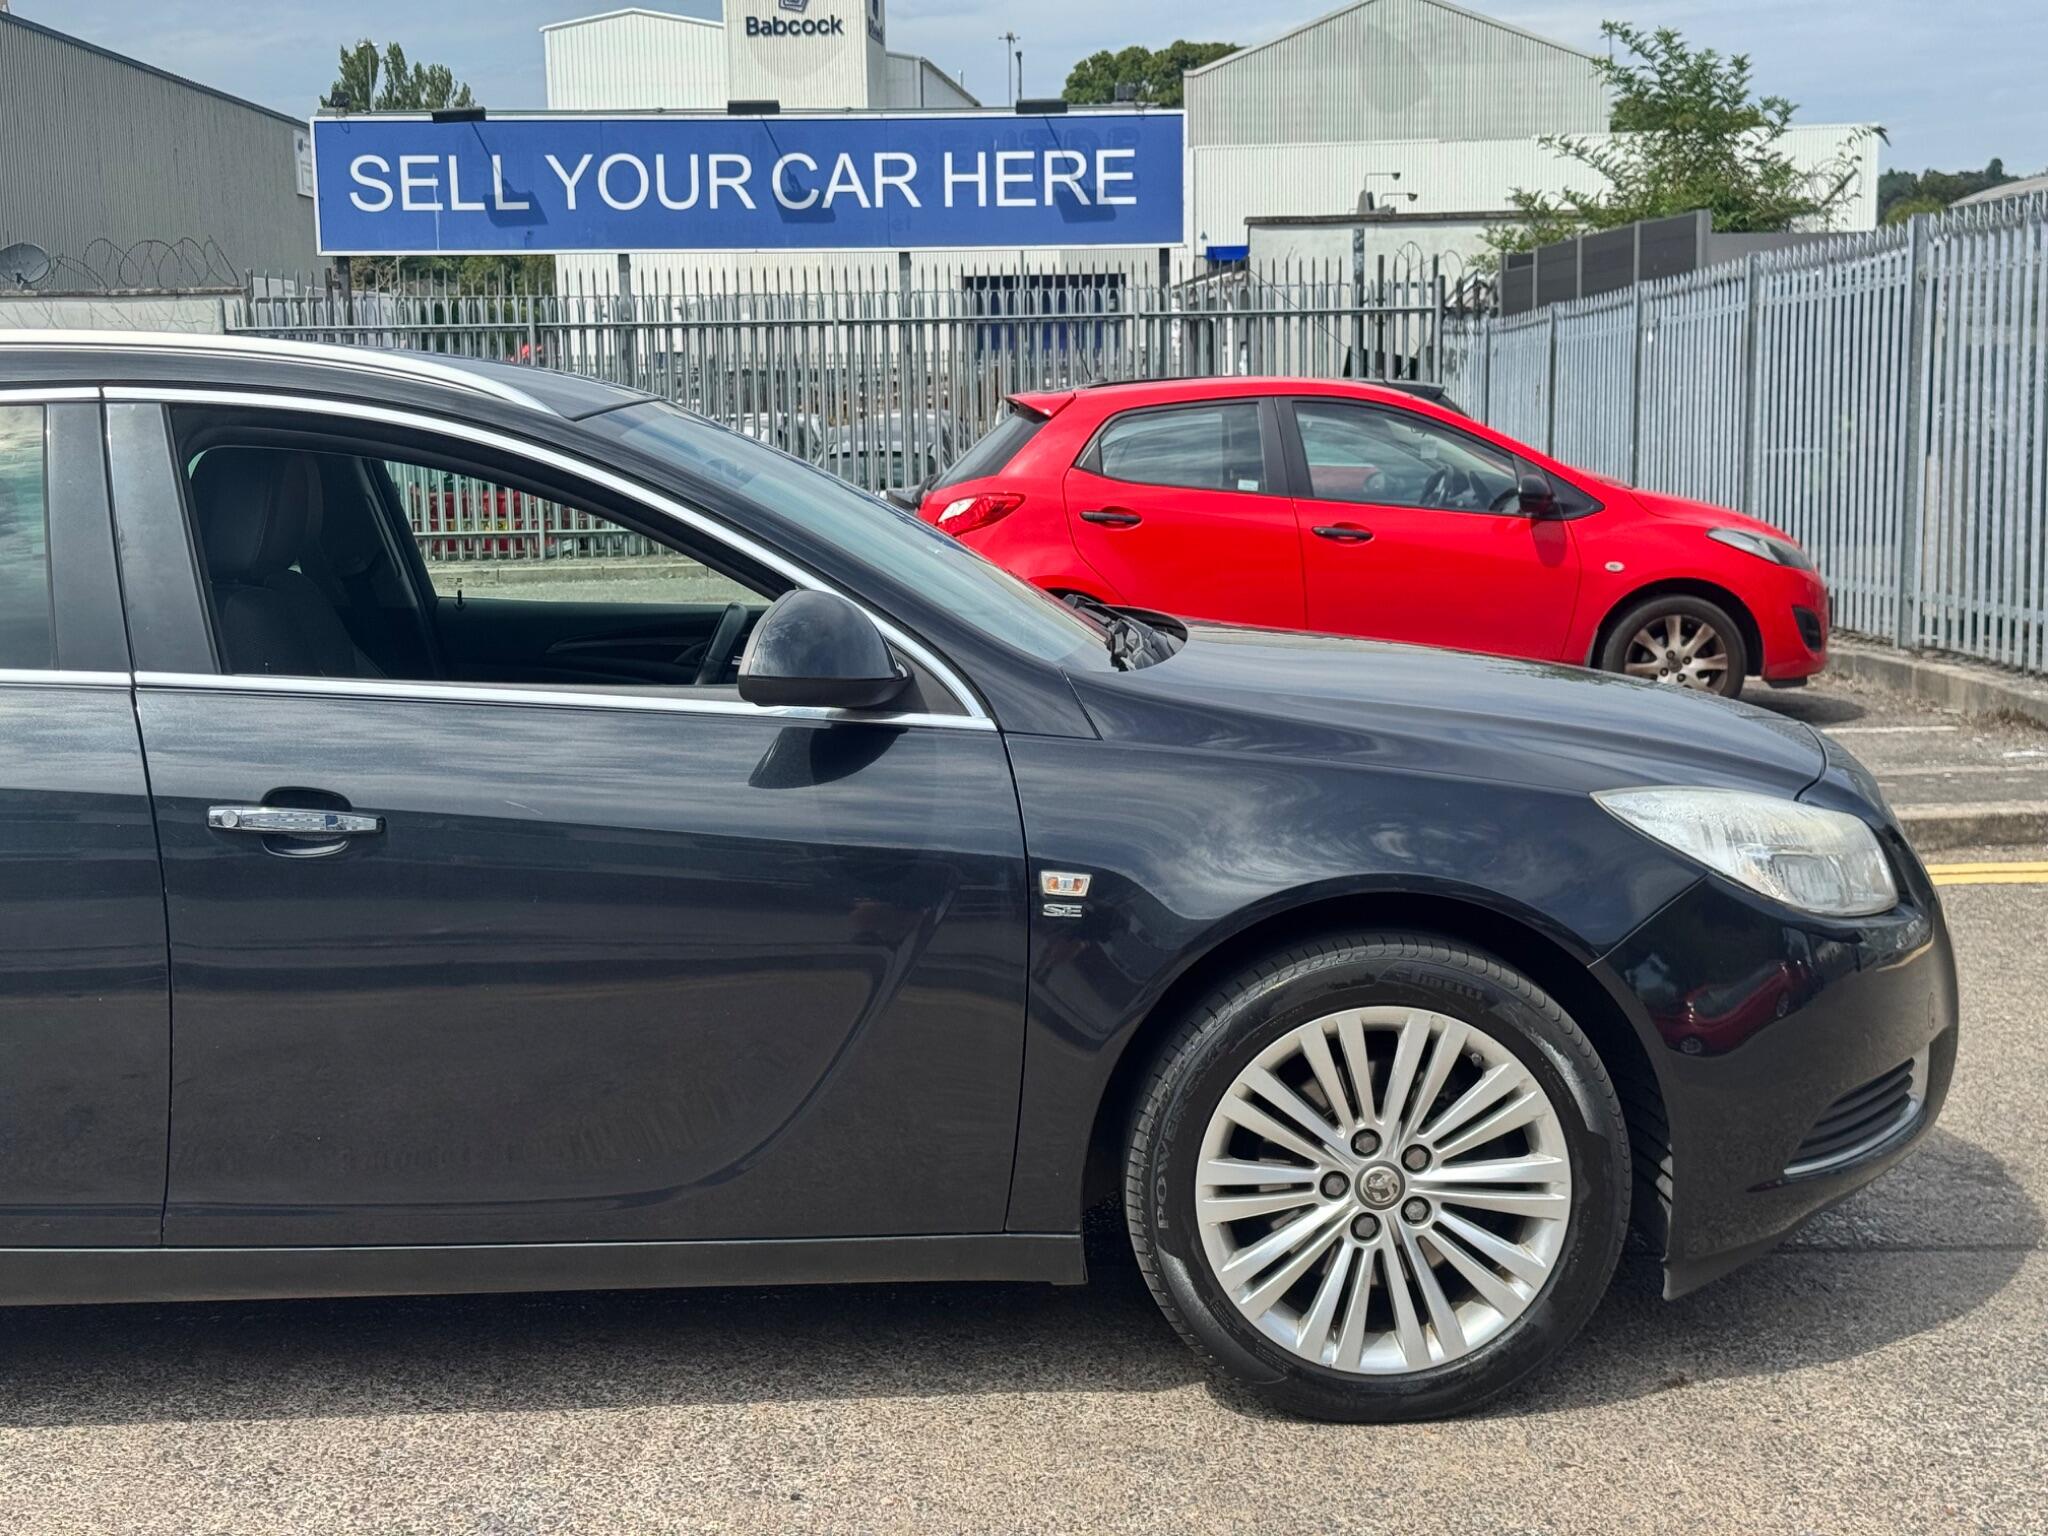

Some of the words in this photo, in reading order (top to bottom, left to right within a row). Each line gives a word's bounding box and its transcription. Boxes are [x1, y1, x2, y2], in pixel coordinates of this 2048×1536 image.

[745, 15, 844, 37] Babcock
[349, 154, 531, 212] SELL
[545, 152, 755, 211] YOUR
[771, 151, 922, 210] CAR
[943, 148, 1137, 207] HERE
[1042, 903, 1083, 918] SE
